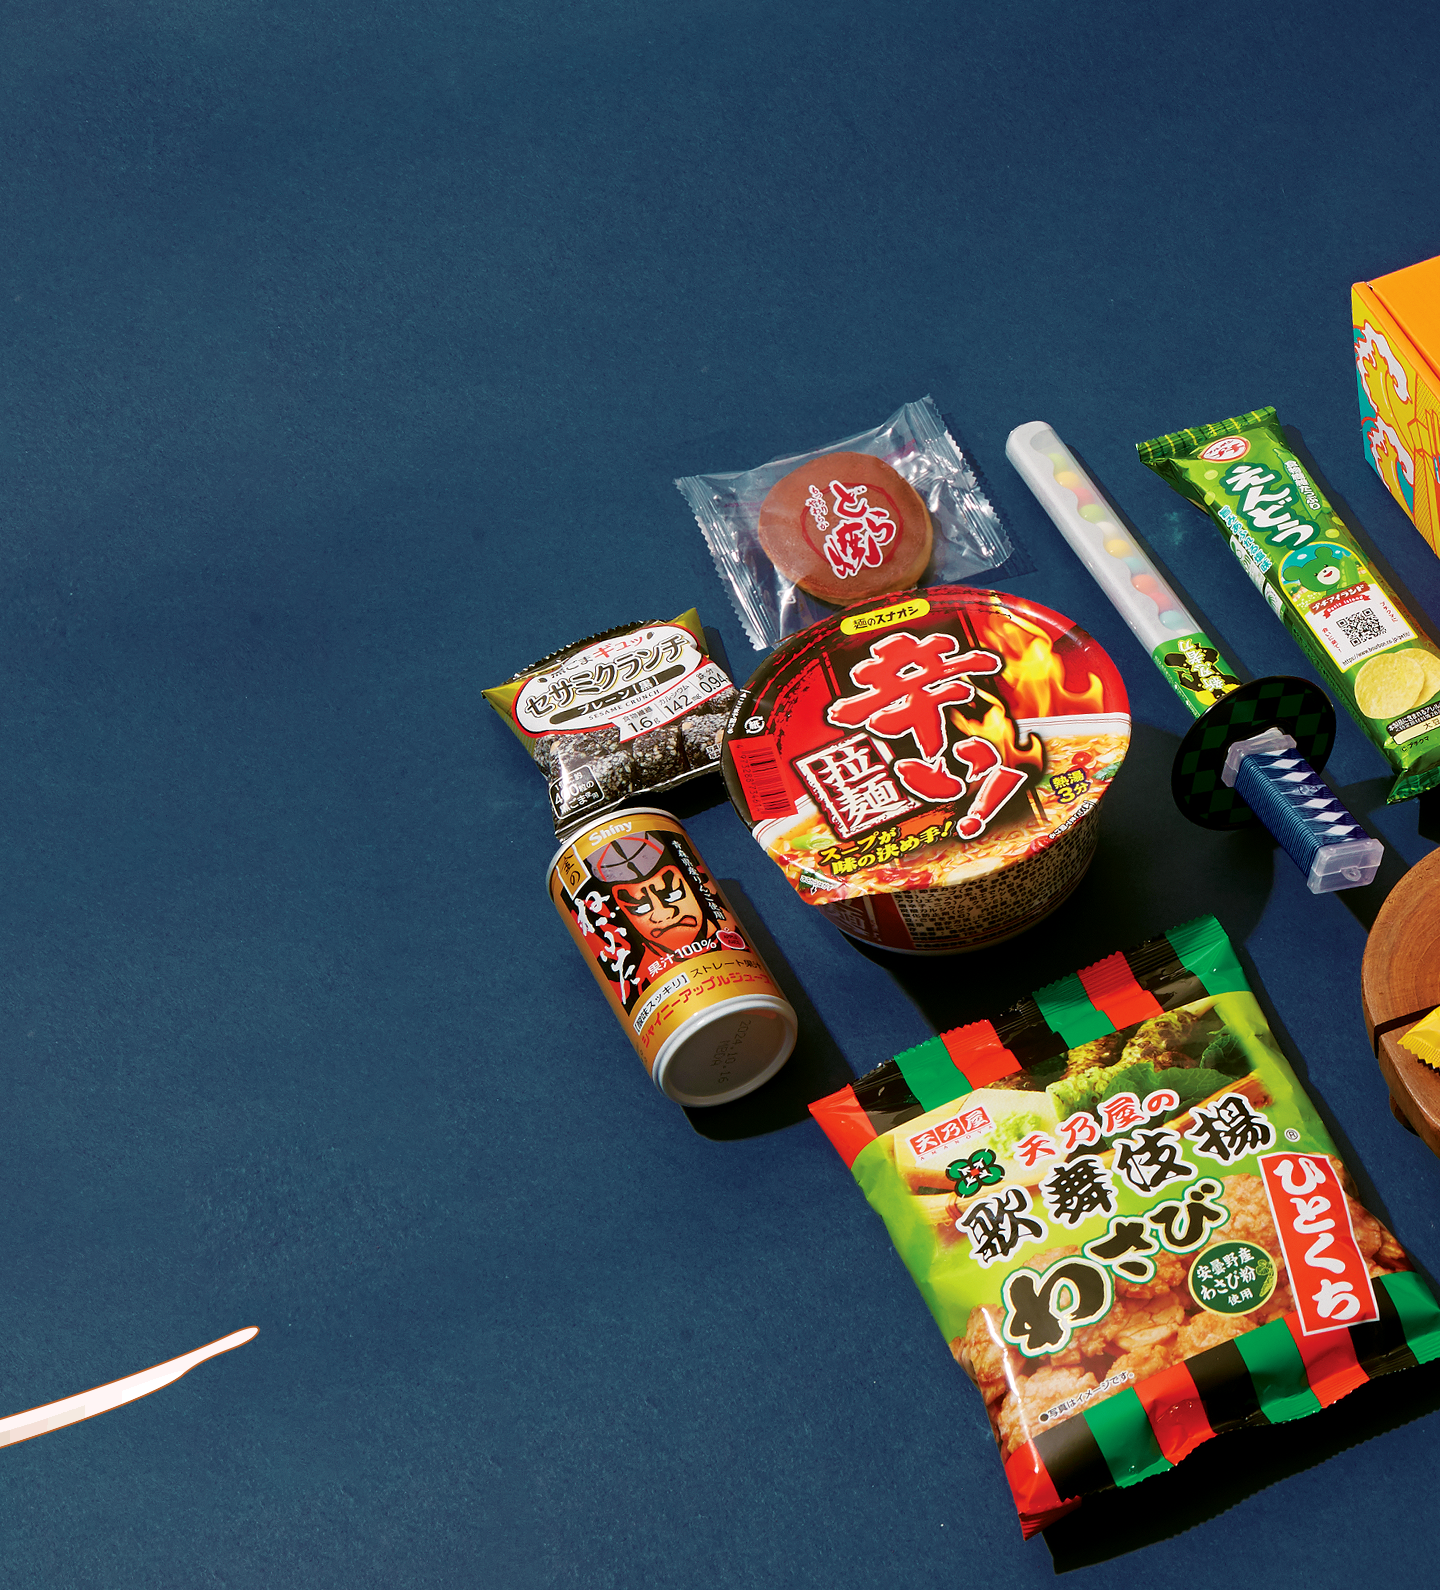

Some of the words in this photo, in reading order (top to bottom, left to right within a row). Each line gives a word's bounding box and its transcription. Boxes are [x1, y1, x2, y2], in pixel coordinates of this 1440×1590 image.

[1225, 465, 1314, 547] えんどう
[525, 633, 690, 719] セサミクランチ
[589, 703, 624, 720] SESAME
[626, 689, 660, 708] CRUNCH
[1423, 718, 1440, 730] 大豆
[1051, 770, 1085, 791] 熱湯
[1059, 782, 1091, 803] 3分
[589, 821, 632, 846] Shiny
[820, 827, 897, 864] スープが
[647, 938, 717, 977] 果汁100%
[914, 1110, 990, 1153] 天乃屋
[1017, 1094, 1177, 1167] 天乃屋の
[961, 1096, 1274, 1262] 歌舞伎揚
[1273, 1158, 1362, 1321] ひとくち
[1009, 1184, 1222, 1351] わさび
[1197, 1243, 1255, 1280] 安曇野産
[1200, 1266, 1257, 1302] わさび粉
[1227, 1289, 1254, 1306] 使用
